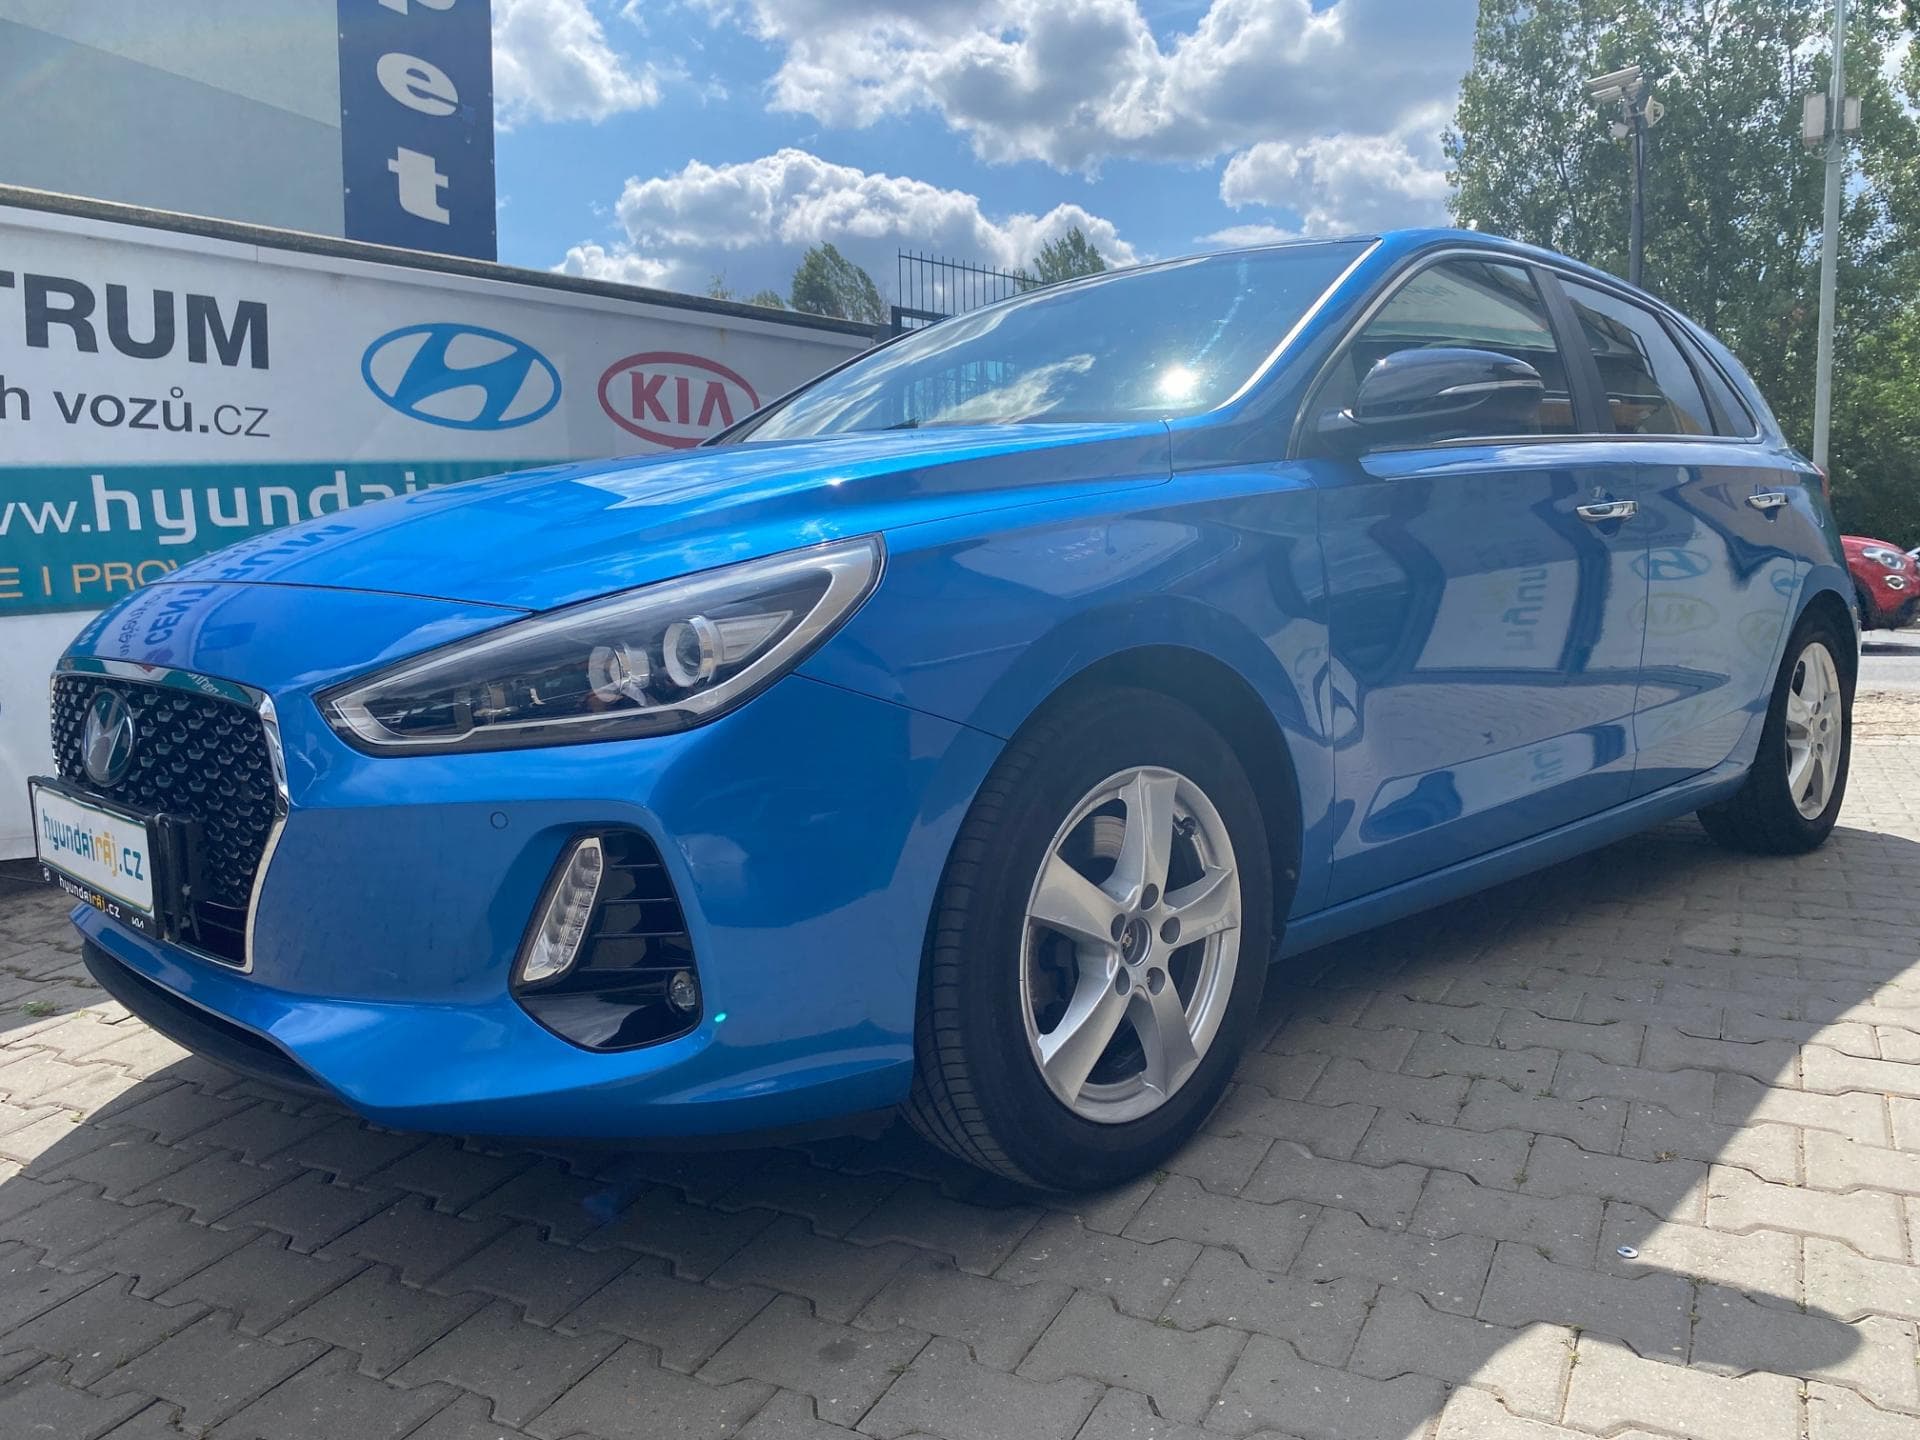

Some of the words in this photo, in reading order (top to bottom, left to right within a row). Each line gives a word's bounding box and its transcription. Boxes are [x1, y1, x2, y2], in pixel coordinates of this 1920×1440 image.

[377, 0, 458, 225] et
[0, 270, 269, 370] RUM
[53, 386, 270, 437] vozů.cz
[629, 371, 734, 428] KIA
[72, 559, 178, 593] PRO
